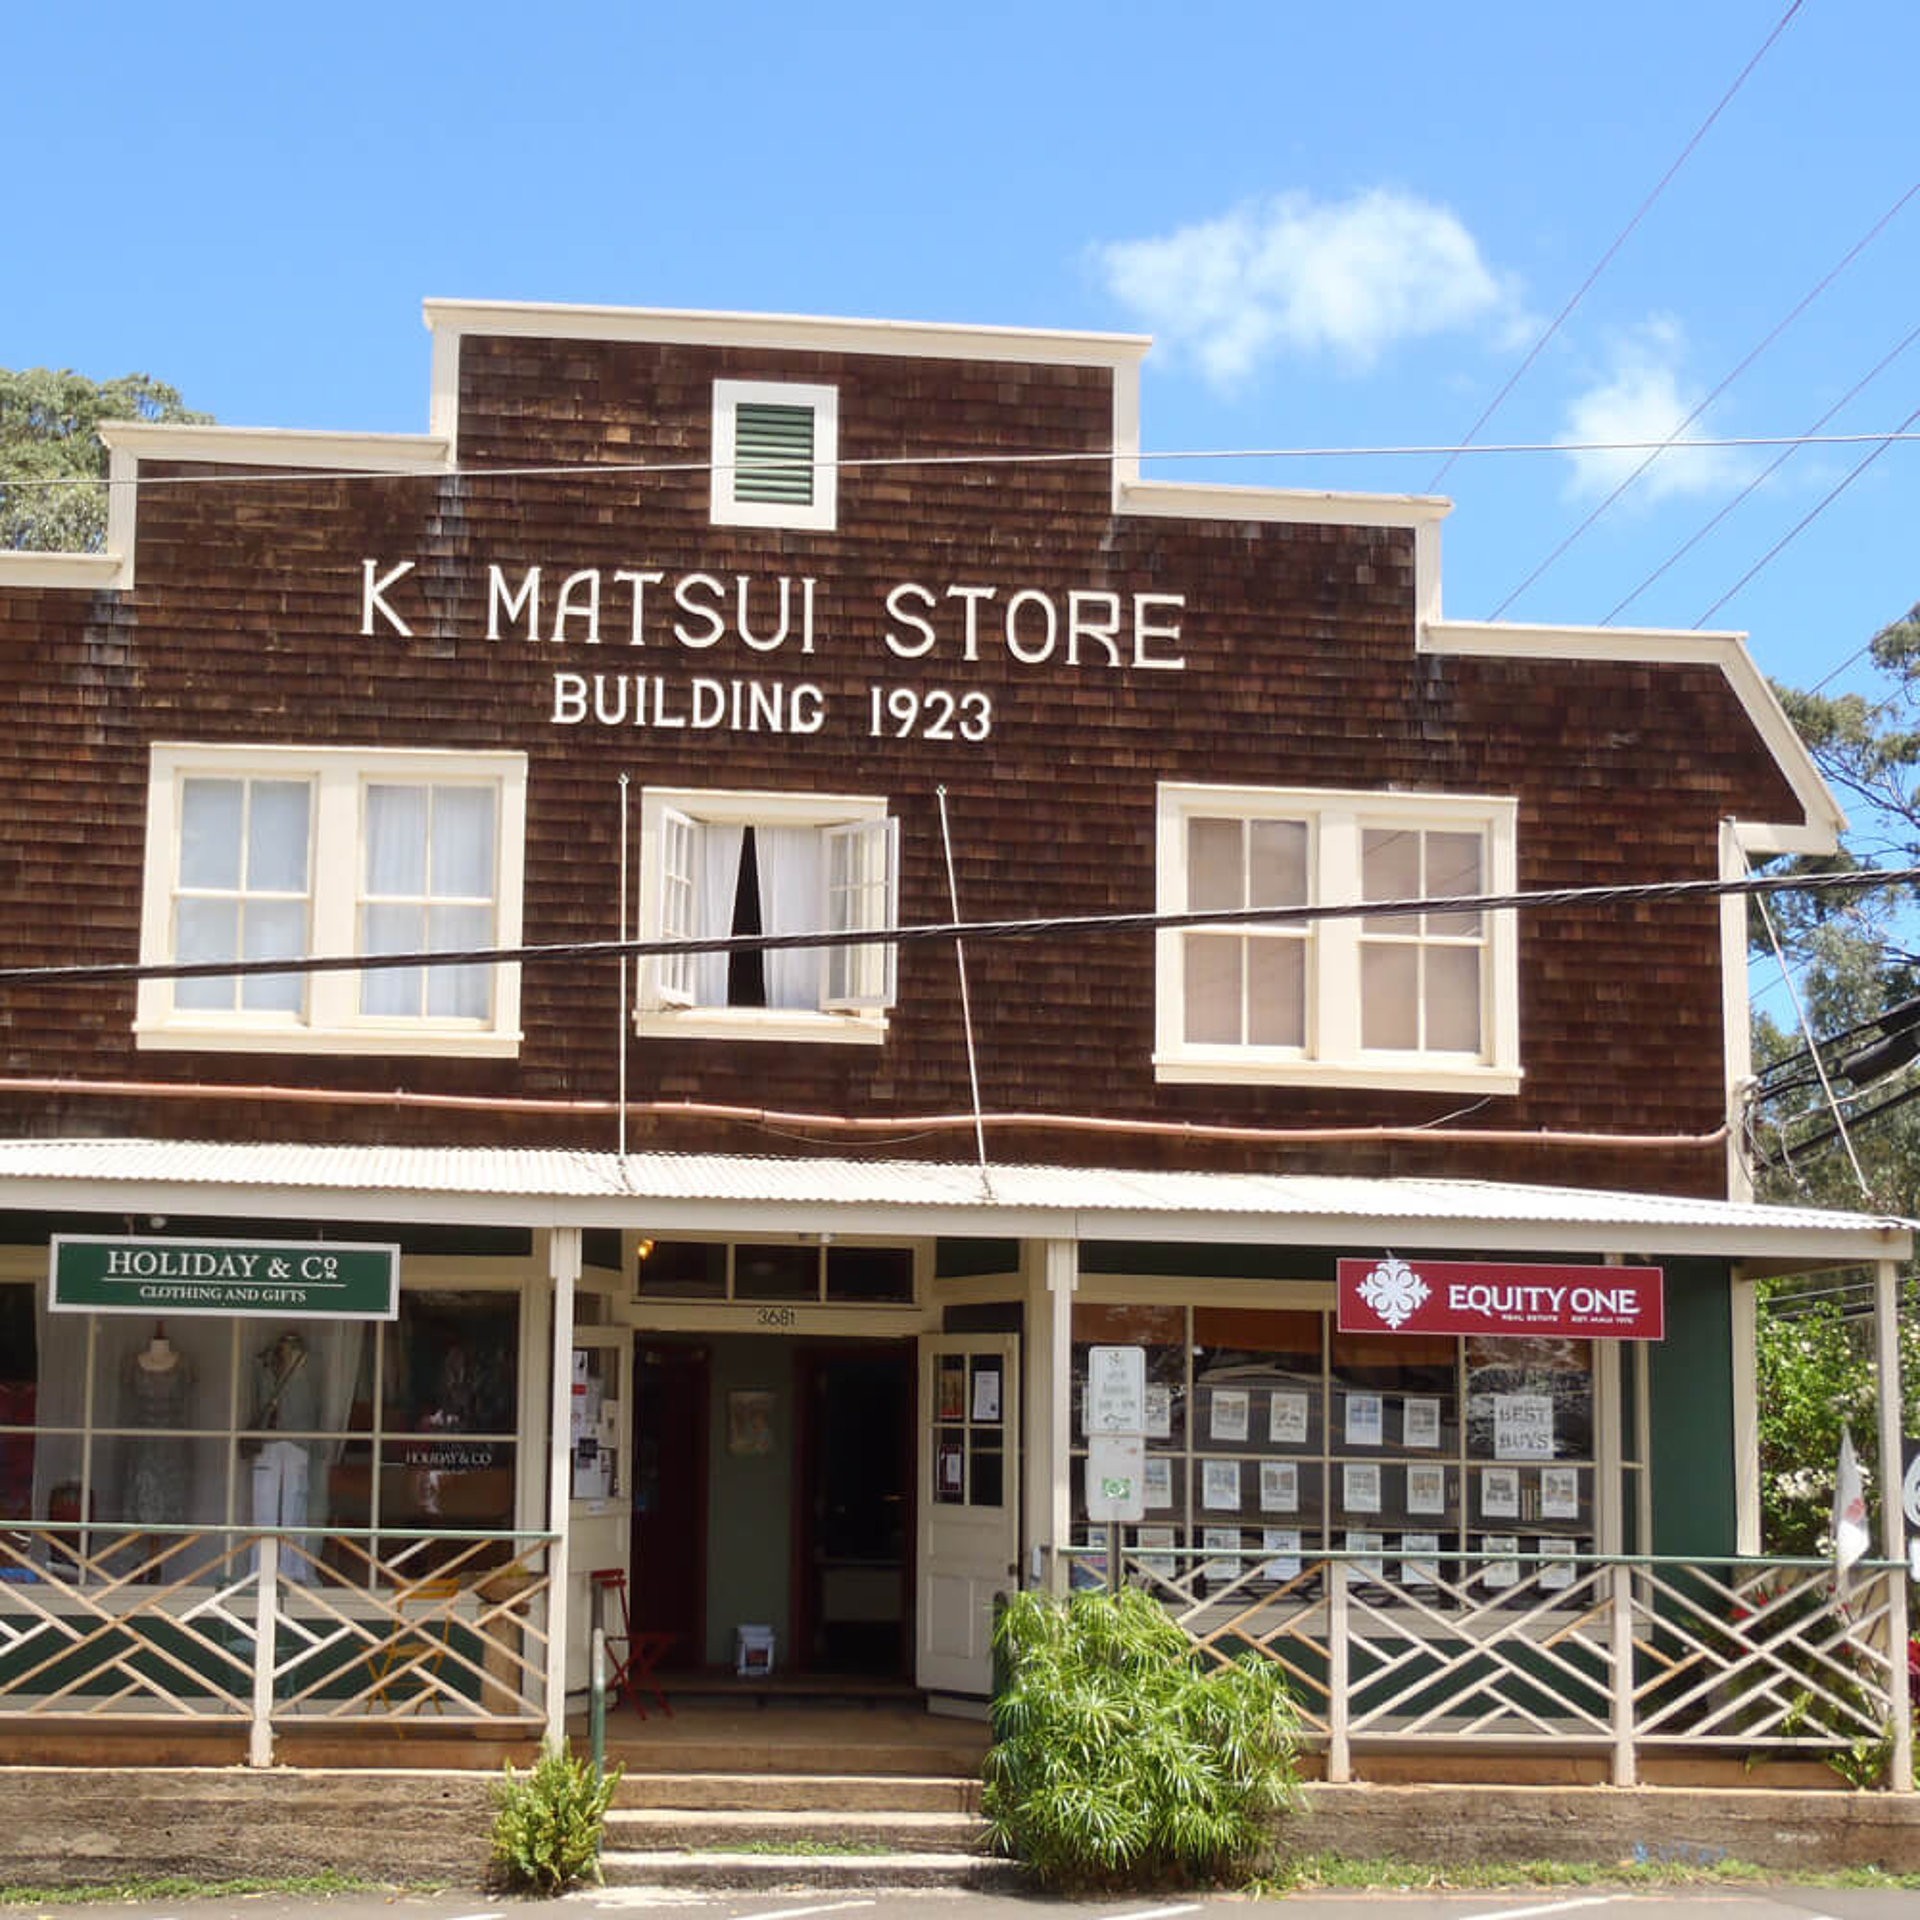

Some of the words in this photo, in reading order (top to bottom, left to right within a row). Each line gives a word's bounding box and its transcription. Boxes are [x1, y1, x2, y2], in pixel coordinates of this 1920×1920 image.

[360, 559, 415, 637] K
[486, 564, 817, 653] MATSUI
[885, 583, 1186, 669] STORE
[551, 673, 825, 734] BUILDING
[868, 686, 992, 741] 1923
[107, 1250, 261, 1278] HOLIDAY
[267, 1256, 291, 1279] &
[139, 1285, 222, 1300] CLOTHING
[224, 1287, 259, 1301] AND
[262, 1289, 307, 1303] GIFTS
[758, 1307, 796, 1326] 3681
